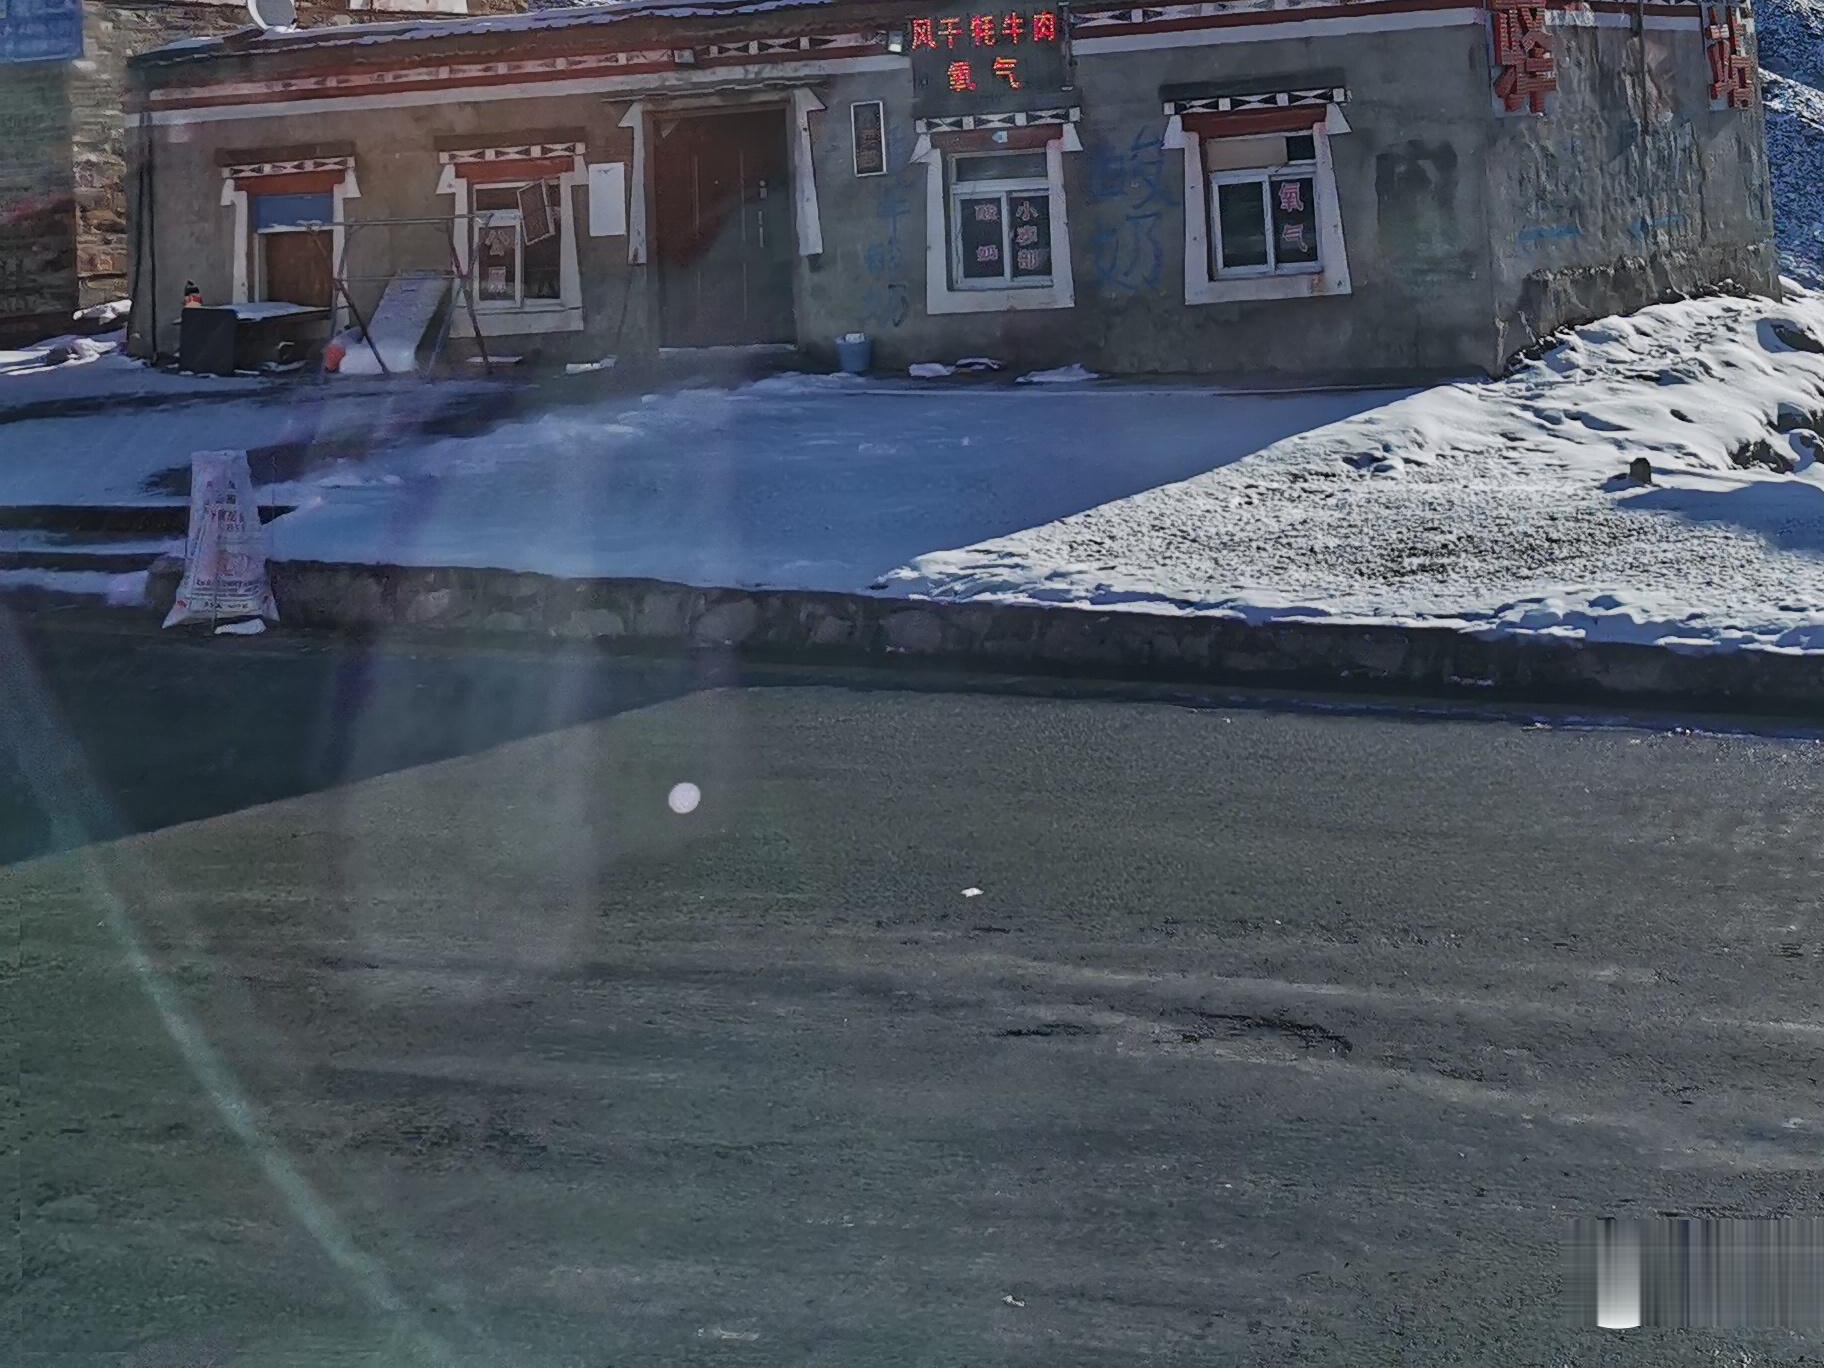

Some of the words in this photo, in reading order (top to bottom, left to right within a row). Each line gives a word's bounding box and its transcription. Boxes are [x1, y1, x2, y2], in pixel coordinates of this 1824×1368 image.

[911, 9, 1057, 50] 风干牦牛肉
[947, 56, 1022, 92] 氧气
[1278, 182, 1308, 253] 氧气
